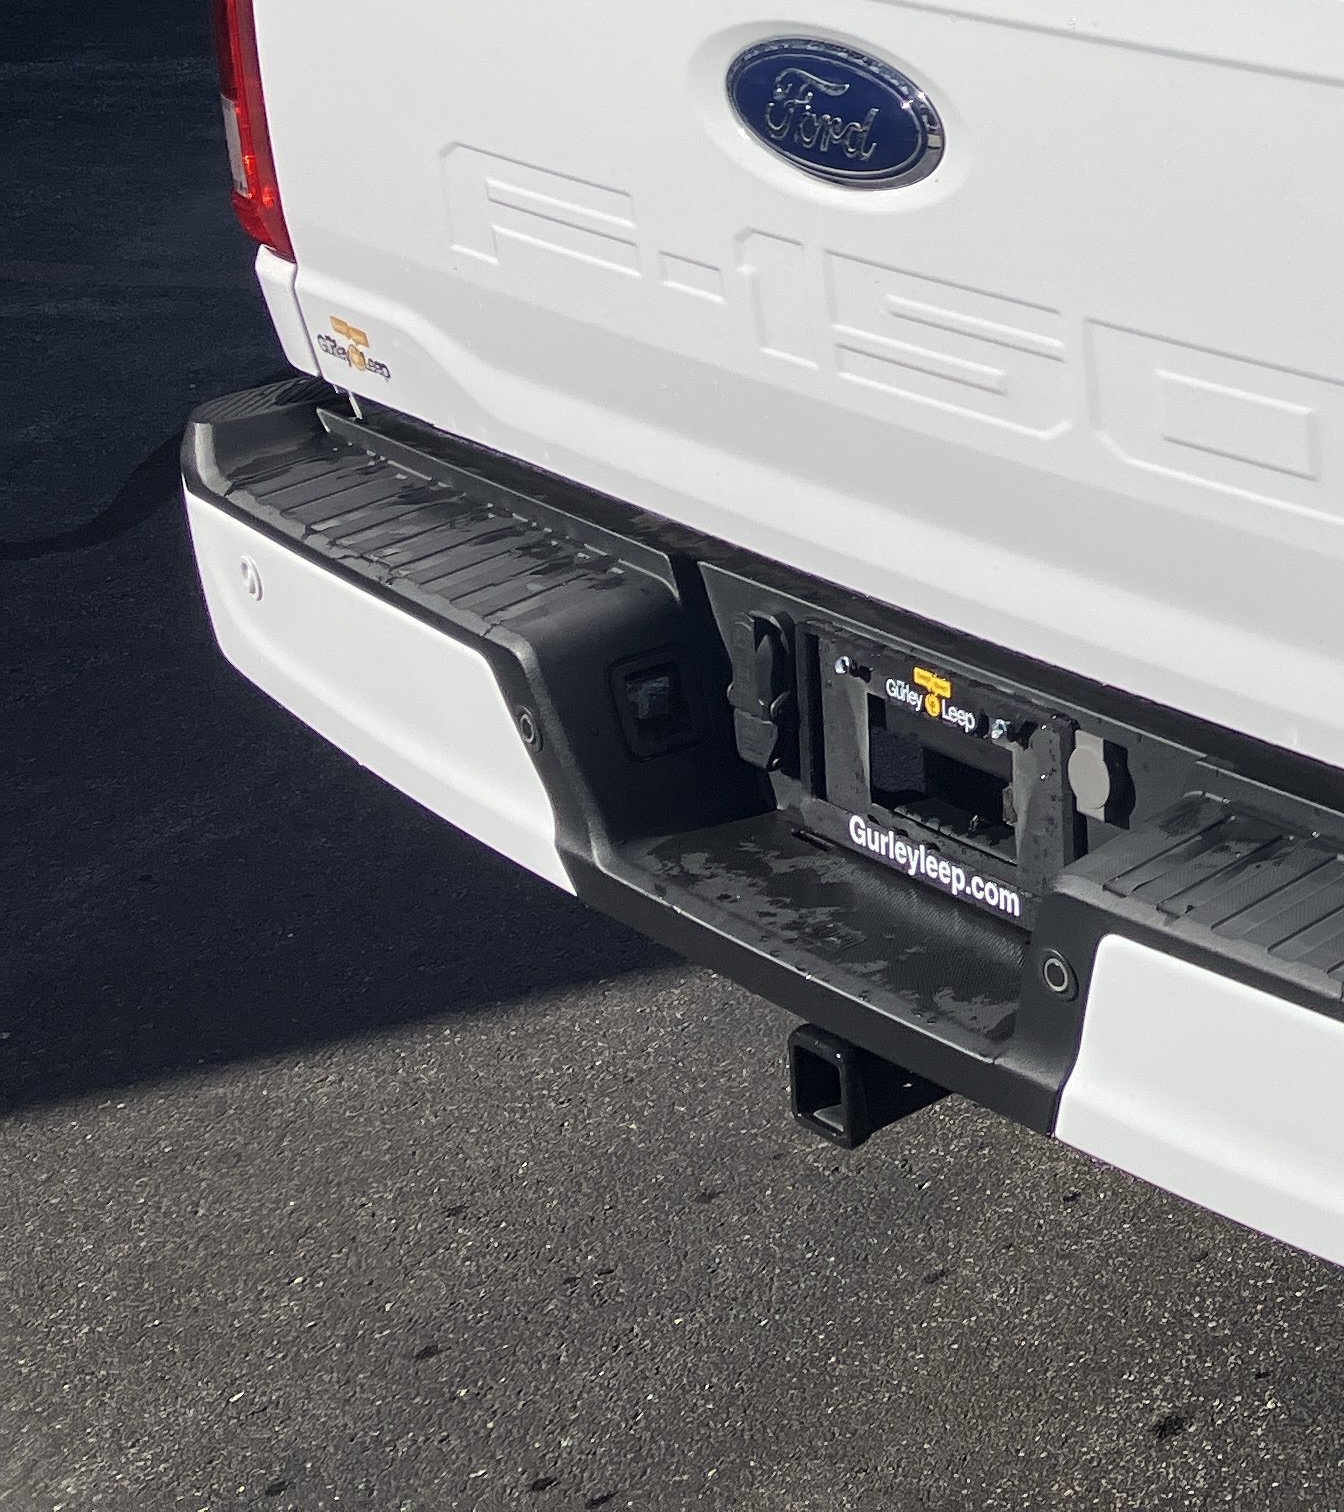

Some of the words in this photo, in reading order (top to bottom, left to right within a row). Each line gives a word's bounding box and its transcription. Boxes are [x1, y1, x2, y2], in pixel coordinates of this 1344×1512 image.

[765, 67, 878, 162] Ford
[941, 698, 976, 734] Leep
[848, 815, 1021, 917] Gurleyleep.com
